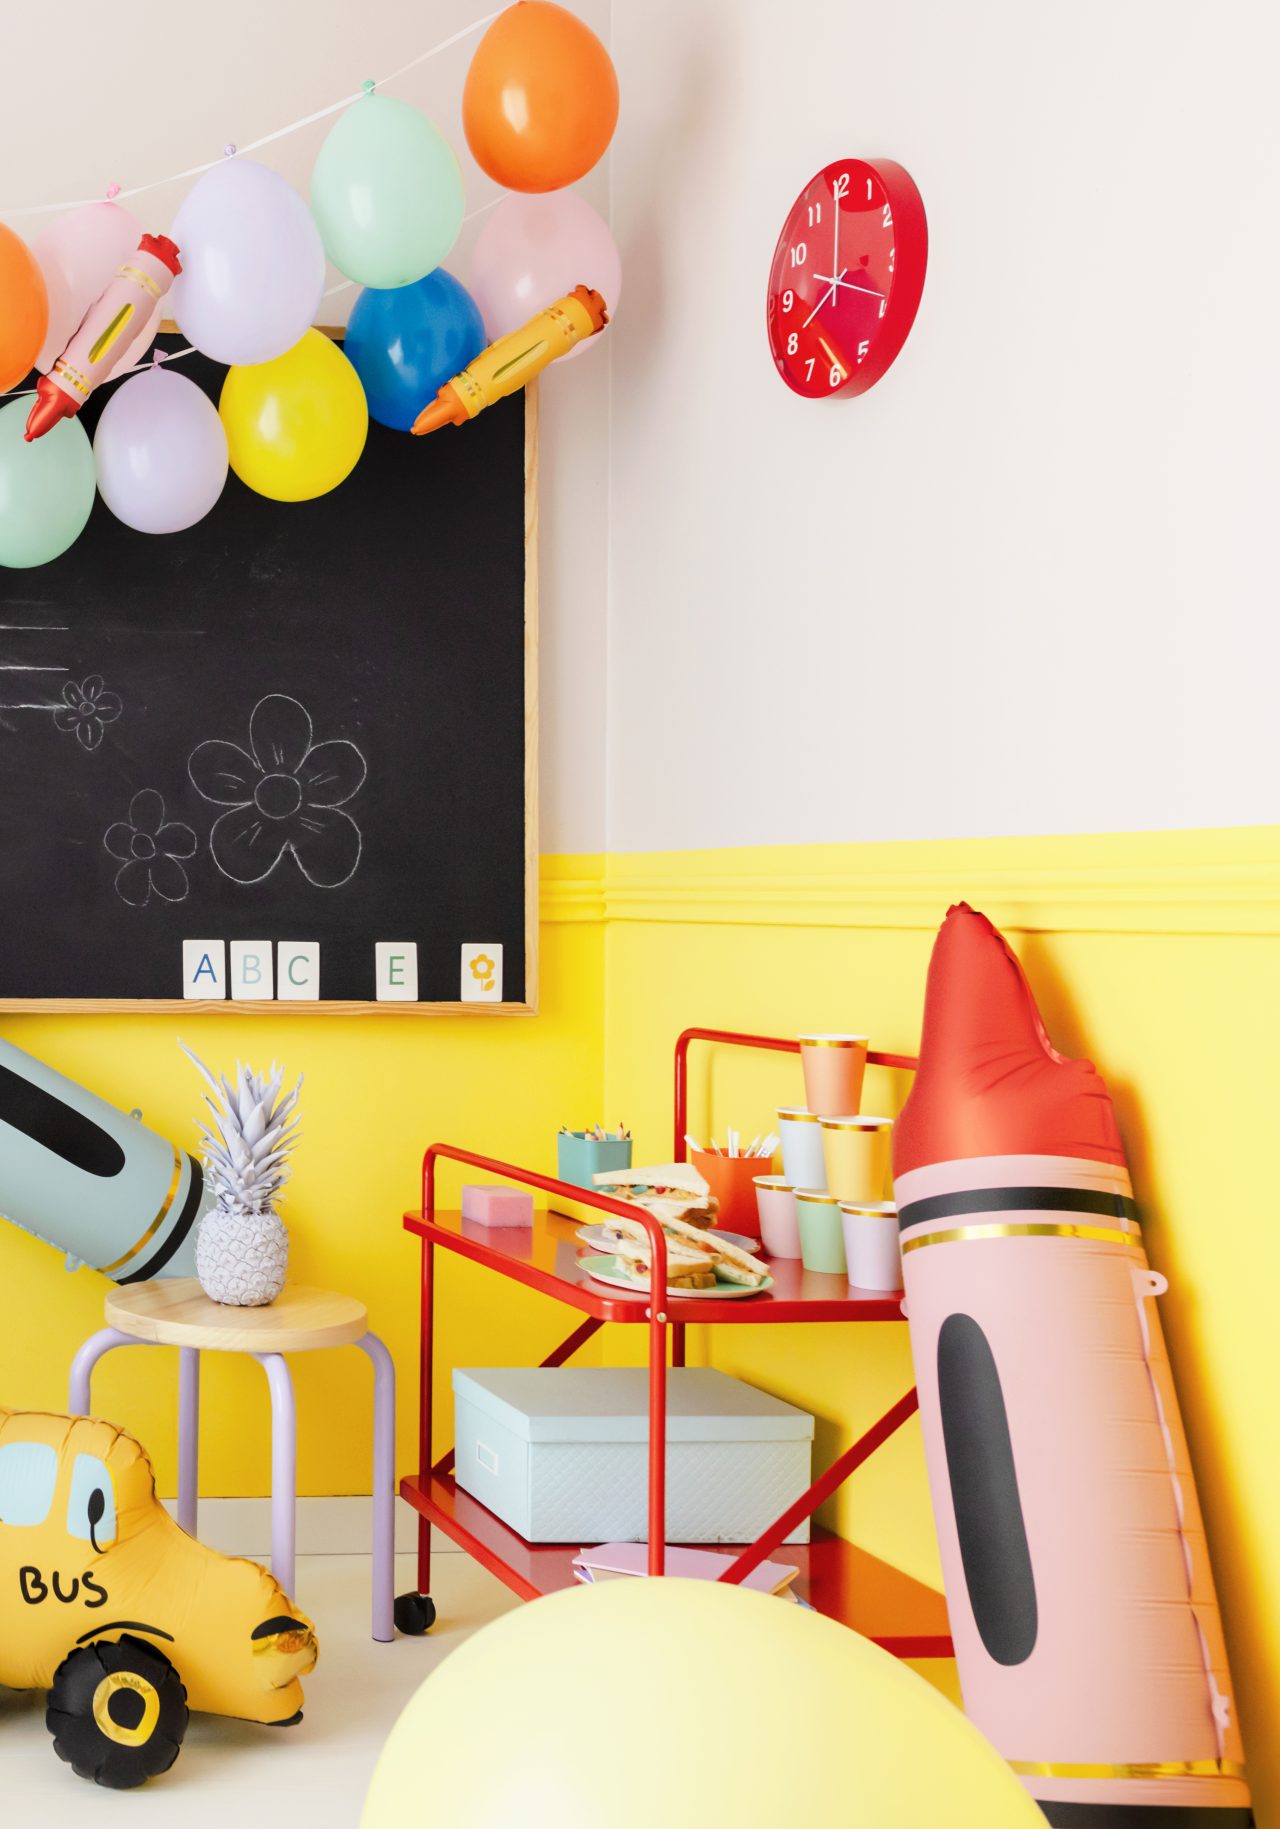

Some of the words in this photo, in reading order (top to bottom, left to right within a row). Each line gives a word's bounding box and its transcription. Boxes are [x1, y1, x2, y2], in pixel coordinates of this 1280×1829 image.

[833, 173, 850, 200] 12
[866, 178, 872, 200] 1
[808, 203, 820, 227] 11
[883, 203, 893, 228] 2
[791, 243, 806, 267] 10
[783, 290, 793, 312] 9
[787, 332, 798, 355] 8
[858, 340, 869, 364] 5
[805, 358, 816, 382] 7
[829, 363, 841, 387] 6
[192, 953, 218, 984] A
[242, 954, 262, 985] B
[288, 955, 310, 986] C
[389, 956, 406, 986] E
[19, 1565, 109, 1608] BUS
